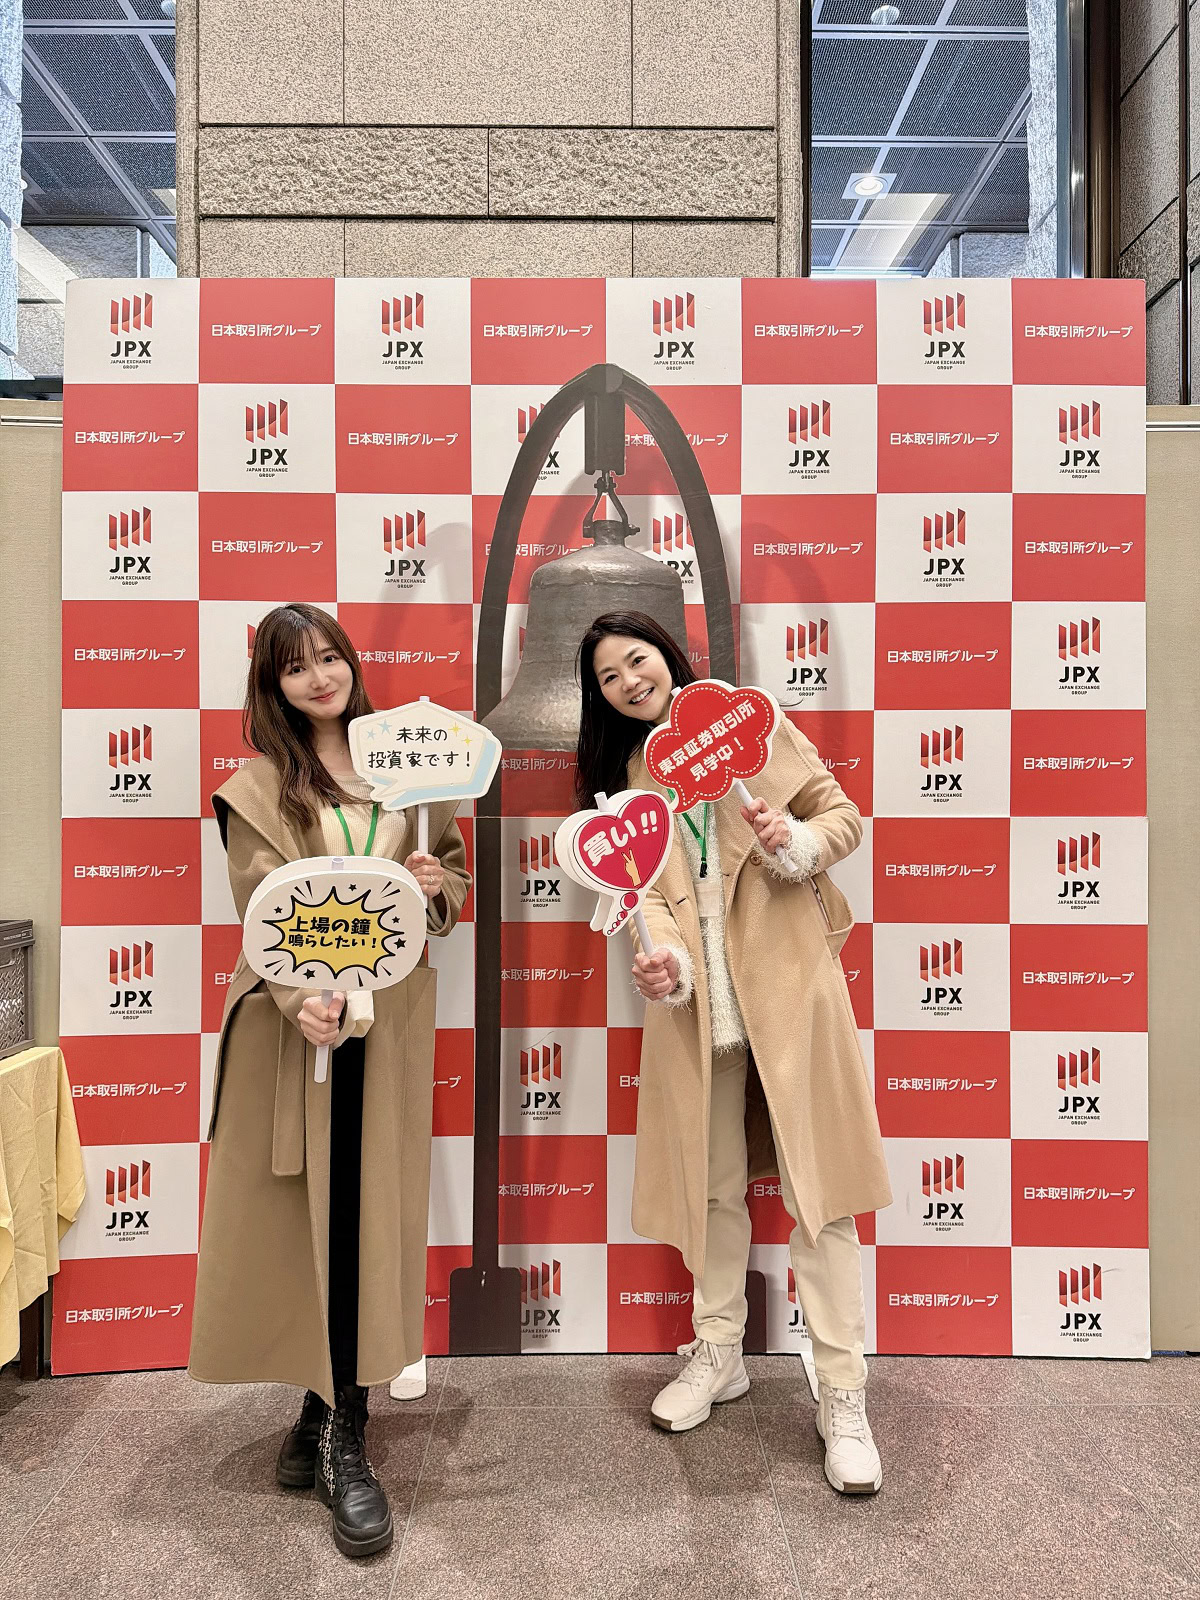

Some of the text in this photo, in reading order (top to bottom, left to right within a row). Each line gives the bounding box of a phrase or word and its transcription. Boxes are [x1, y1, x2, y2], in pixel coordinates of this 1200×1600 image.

[212, 324, 321, 336] 日本取引所グループ
[484, 324, 593, 337] 日本取引所グループ
[755, 324, 864, 336] 日本取引所グループ
[1025, 325, 1133, 338] 日本取引所グループ
[111, 341, 151, 357] JPX
[382, 342, 423, 357] JPX
[654, 342, 694, 358] JPX
[925, 342, 965, 357] JPX
[75, 431, 185, 443] 日本取引所グループ
[349, 432, 458, 445] 日本取引所グループ
[891, 432, 999, 445] 日本取引所グループ
[246, 449, 288, 465] JPX
[789, 450, 829, 467] JPX
[1060, 450, 1100, 466] JPX
[212, 540, 323, 553] 日本取引所グループ
[754, 542, 863, 555] 日本取引所グループ
[1025, 541, 1133, 554] 日本取引所グループ
[110, 557, 151, 573] JPX
[385, 560, 425, 576] JPX
[924, 559, 964, 575] JPX
[75, 648, 186, 661] 日本取引所グループ
[888, 649, 998, 662] 日本取引所グループ
[787, 668, 827, 684] JPX
[1059, 667, 1099, 682] JPX
[396, 726, 448, 743] 未来の
[657, 699, 757, 776] 東京証券取引所
[368, 750, 471, 769] 投資家です！
[689, 736, 744, 782] 見学中！
[1024, 757, 1134, 769] 日本取引所グループ
[110, 774, 151, 790] JPX
[921, 774, 962, 790] JPX
[583, 811, 657, 866] 買い!!
[74, 865, 188, 878] 日本取引所グループ
[886, 864, 996, 876] 日本取引所グループ
[521, 880, 560, 895] JPX
[1058, 881, 1099, 897] JPX
[289, 915, 371, 935] 上場の鐘
[288, 934, 377, 949] 鳴らしたい！
[501, 968, 594, 981] 本取引所グループ
[1023, 972, 1134, 984] 日本取引所グループ
[110, 991, 152, 1007] JPX
[921, 988, 962, 1004] JPX
[72, 1082, 187, 1097] 日本取引所グループ
[888, 1078, 997, 1090] 日本取引所グループ
[521, 1092, 561, 1108] JPX
[1058, 1097, 1100, 1113] JPX
[498, 1183, 594, 1197] 本取引所グループ
[1024, 1187, 1135, 1200] 日本取引所グループ
[923, 1203, 964, 1219] JPX
[106, 1211, 149, 1229] JPX
[620, 1292, 692, 1305] 日本取引所グ
[889, 1294, 998, 1306] 日本取引所グループ
[66, 1304, 183, 1323] 日本取引所グループ
[521, 1310, 560, 1326] JPX
[1060, 1313, 1102, 1330] JPX
